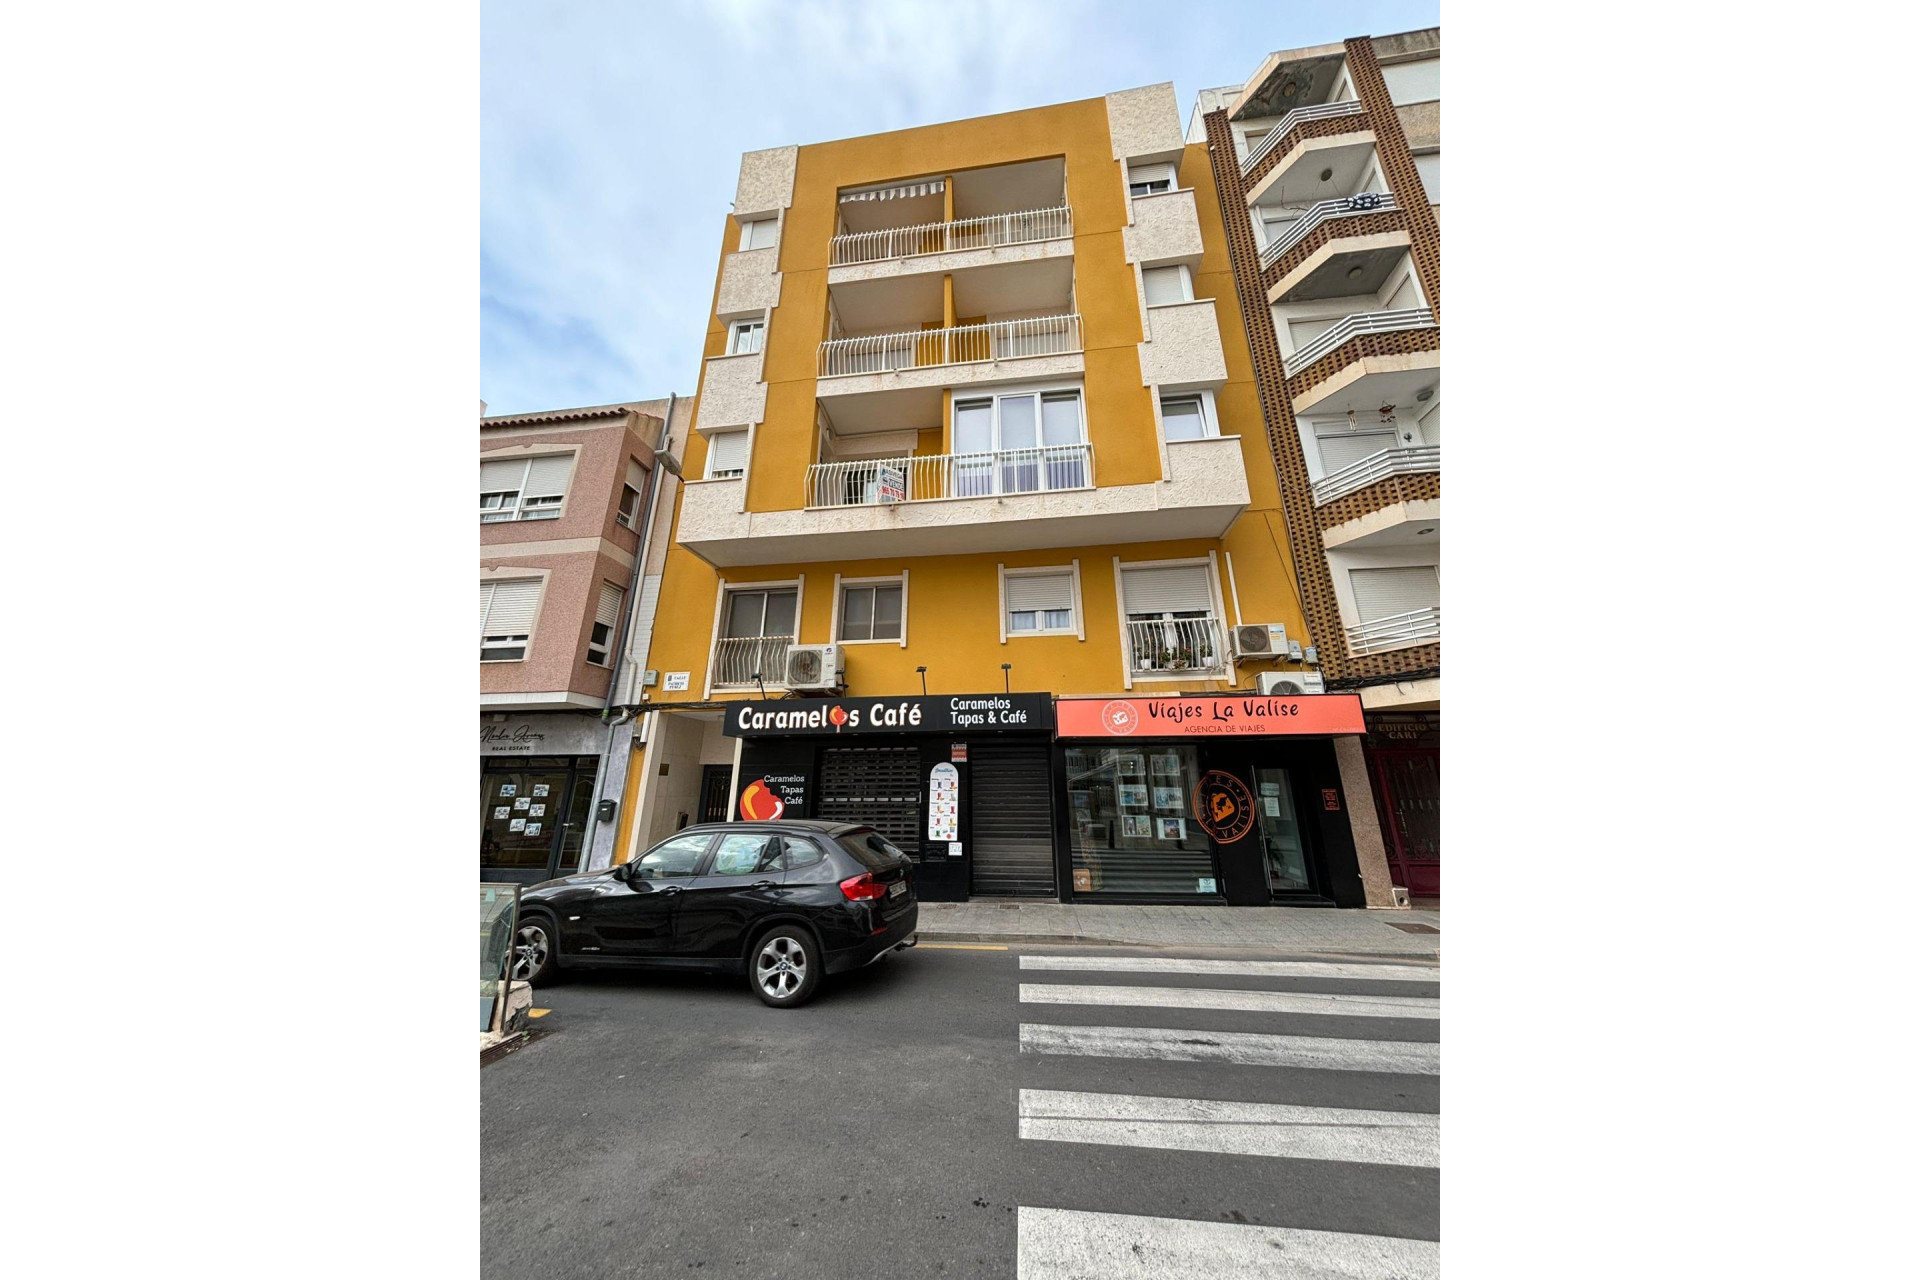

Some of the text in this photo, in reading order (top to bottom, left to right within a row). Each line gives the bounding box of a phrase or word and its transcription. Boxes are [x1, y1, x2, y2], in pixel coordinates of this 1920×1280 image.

[950, 696, 1011, 710] Caramelos
[870, 702, 922, 728] Café
[1148, 701, 1203, 723] Viajes
[1212, 701, 1234, 722] La
[1243, 699, 1299, 717] Valise
[950, 709, 1027, 728] Tapas & Café
[1184, 724, 1266, 733] AGENCIA DE VIAJES
[764, 774, 805, 783] Caramelos
[780, 785, 804, 796] Tapas
[784, 796, 803, 805] Café
